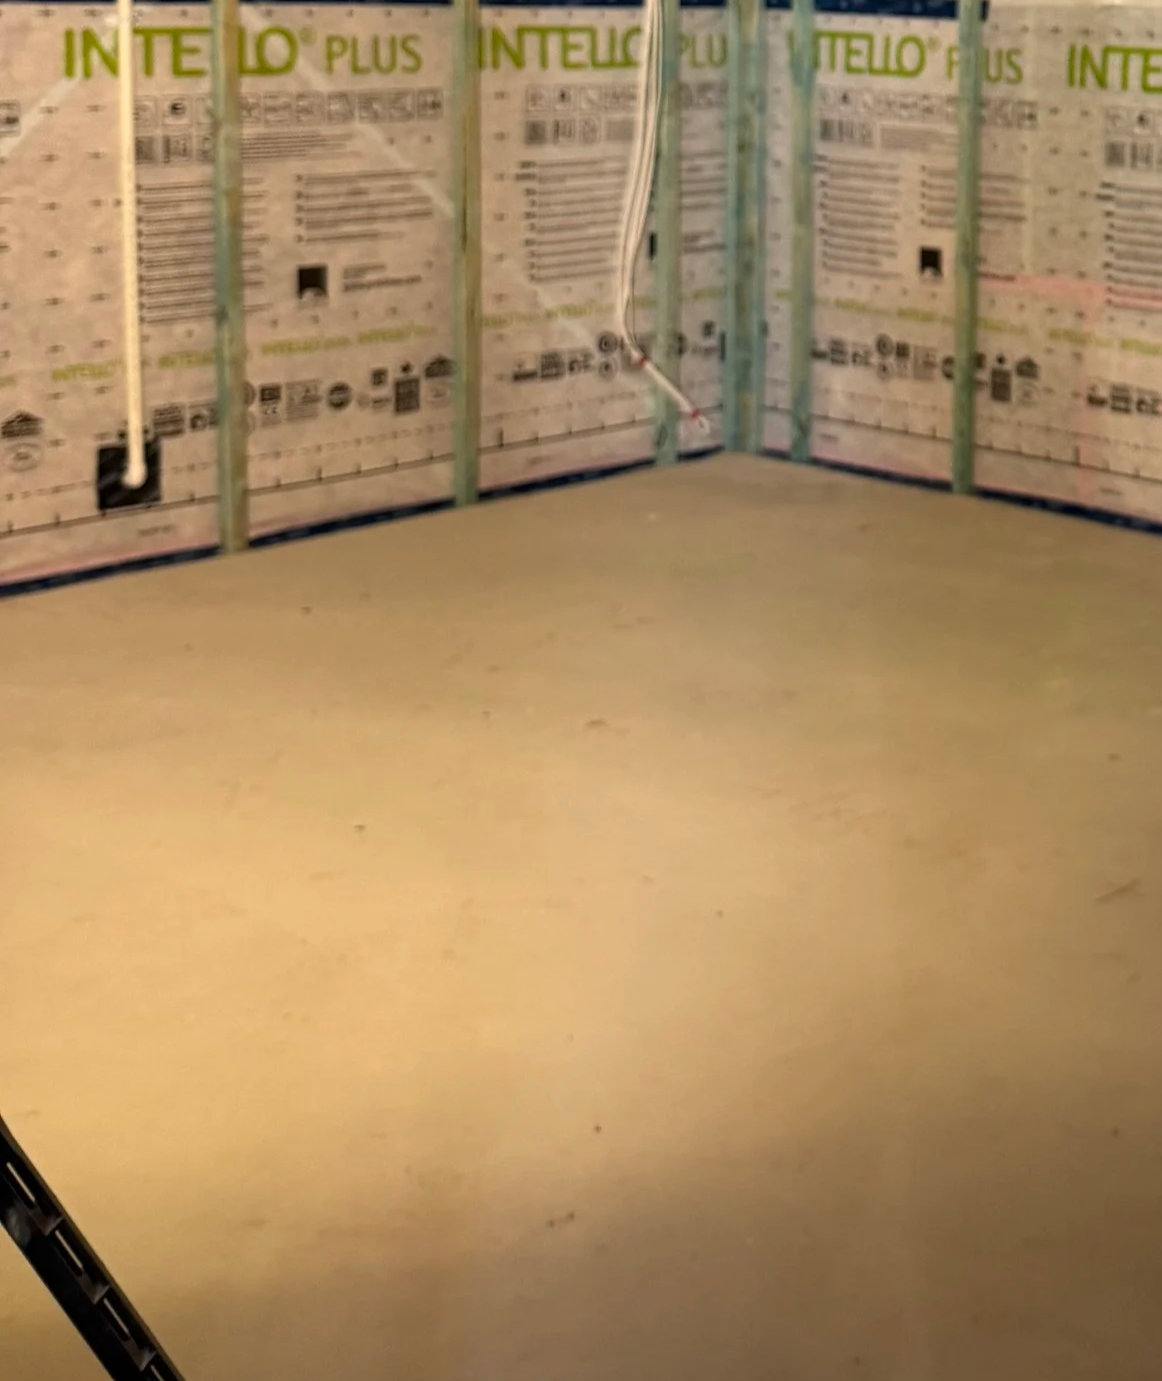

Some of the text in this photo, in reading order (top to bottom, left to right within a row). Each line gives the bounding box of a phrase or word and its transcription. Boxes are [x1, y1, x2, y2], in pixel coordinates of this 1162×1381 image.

[325, 33, 423, 76] PLUS
[678, 32, 728, 69] PLU
[945, 45, 1024, 85] PUS
